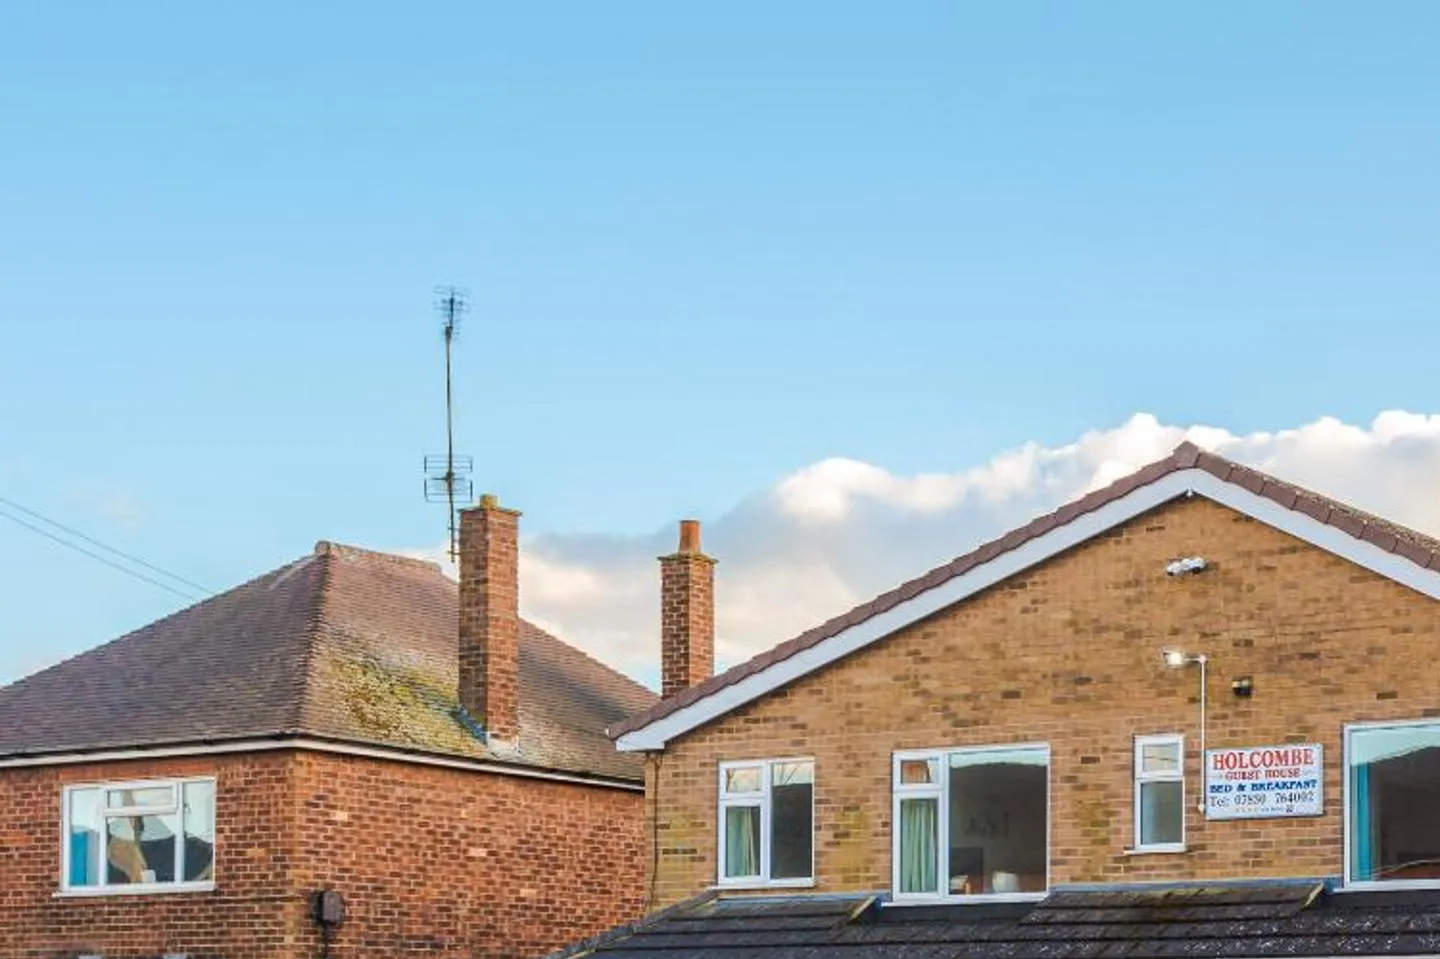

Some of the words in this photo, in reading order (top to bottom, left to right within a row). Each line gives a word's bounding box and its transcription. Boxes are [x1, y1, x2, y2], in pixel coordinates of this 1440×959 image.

[1213, 748, 1314, 770] HOLCOMBE
[1225, 770, 1262, 781] GUEST
[1264, 768, 1301, 779] HOUSE
[1209, 784, 1233, 794] BED
[1236, 783, 1247, 792] &
[1251, 779, 1318, 791] BREAKFAST
